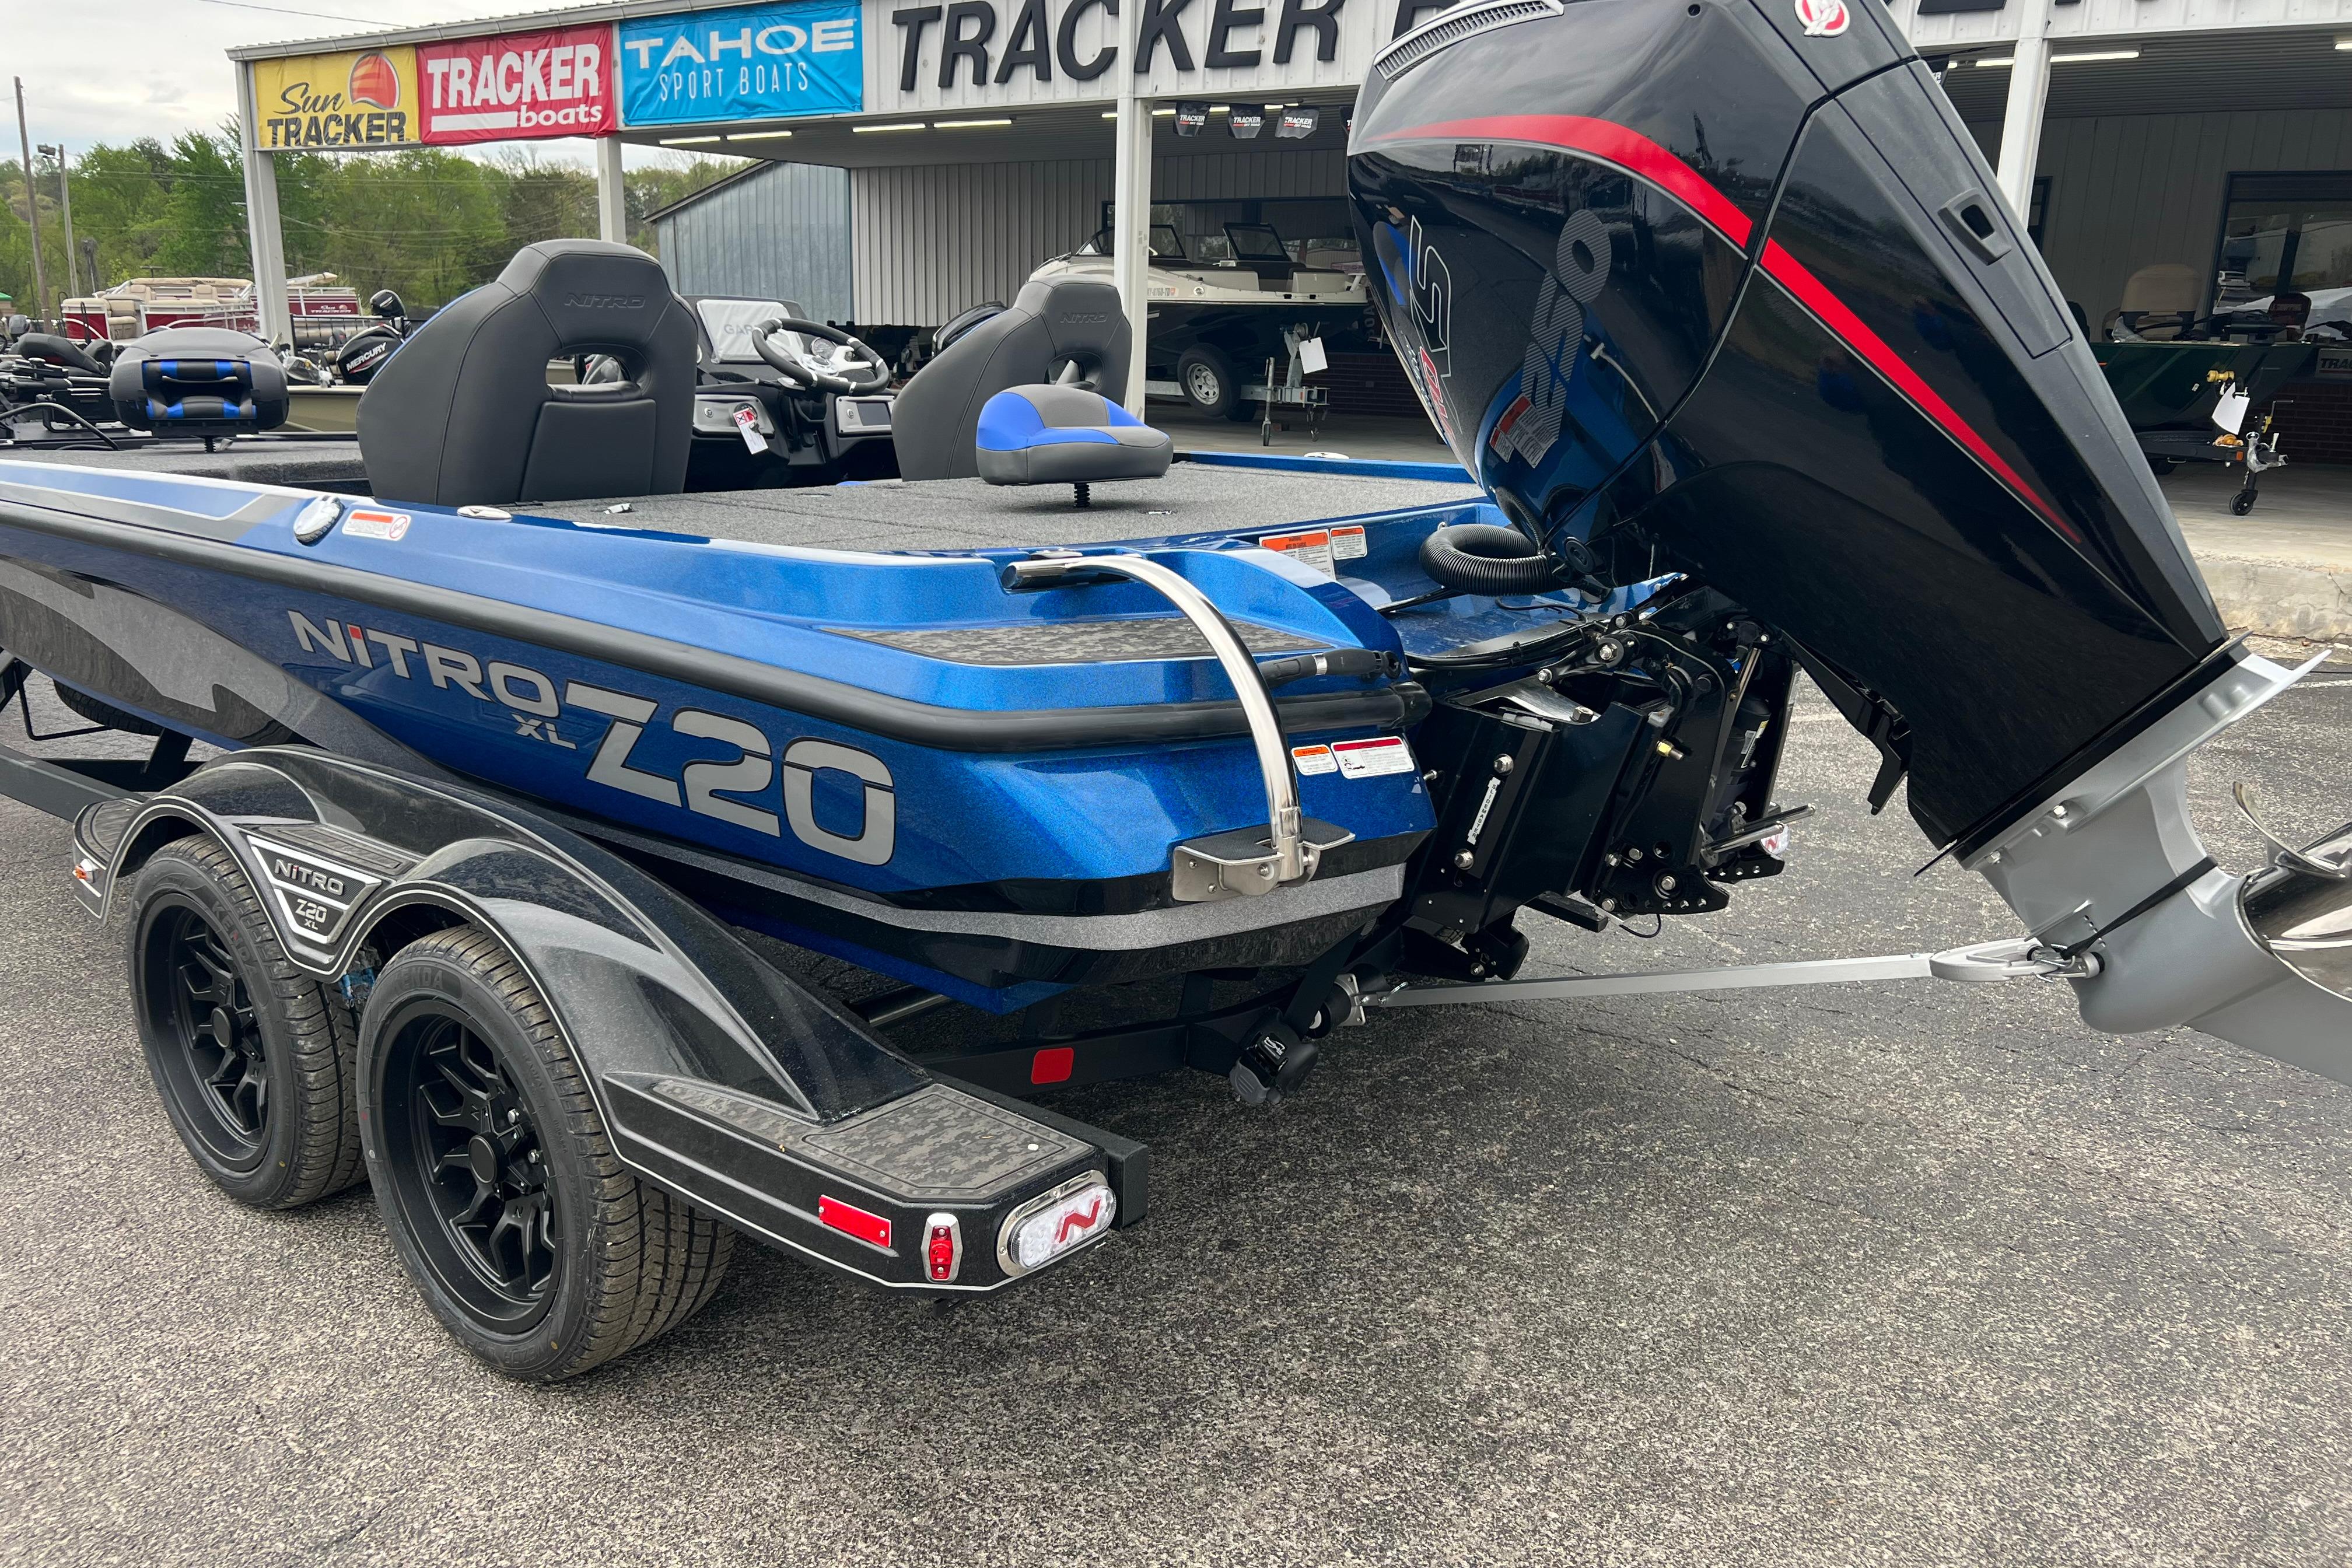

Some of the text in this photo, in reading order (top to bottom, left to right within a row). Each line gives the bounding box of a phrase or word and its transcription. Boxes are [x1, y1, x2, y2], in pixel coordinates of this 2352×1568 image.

[624, 18, 854, 69] TAHOE
[891, 0, 1346, 91] TRACKER
[427, 43, 601, 109] TRACKER
[659, 61, 808, 102] SPORT BOATS
[272, 82, 345, 115] Sun
[520, 103, 602, 128] boats
[267, 111, 407, 148] TRACKER
[1284, 116, 1312, 125] TRACKER
[564, 292, 646, 309] NITRO
[1059, 312, 1108, 323] NITRO
[723, 323, 753, 336] GAR
[345, 341, 387, 372] MERCURY
[286, 608, 897, 866] NITRO Z20
[510, 712, 577, 750] XL
[1471, 783, 1497, 838] SLIDEMASTER
[274, 859, 344, 895] NITRO
[295, 898, 327, 923] Z20
[303, 918, 318, 930] XL
